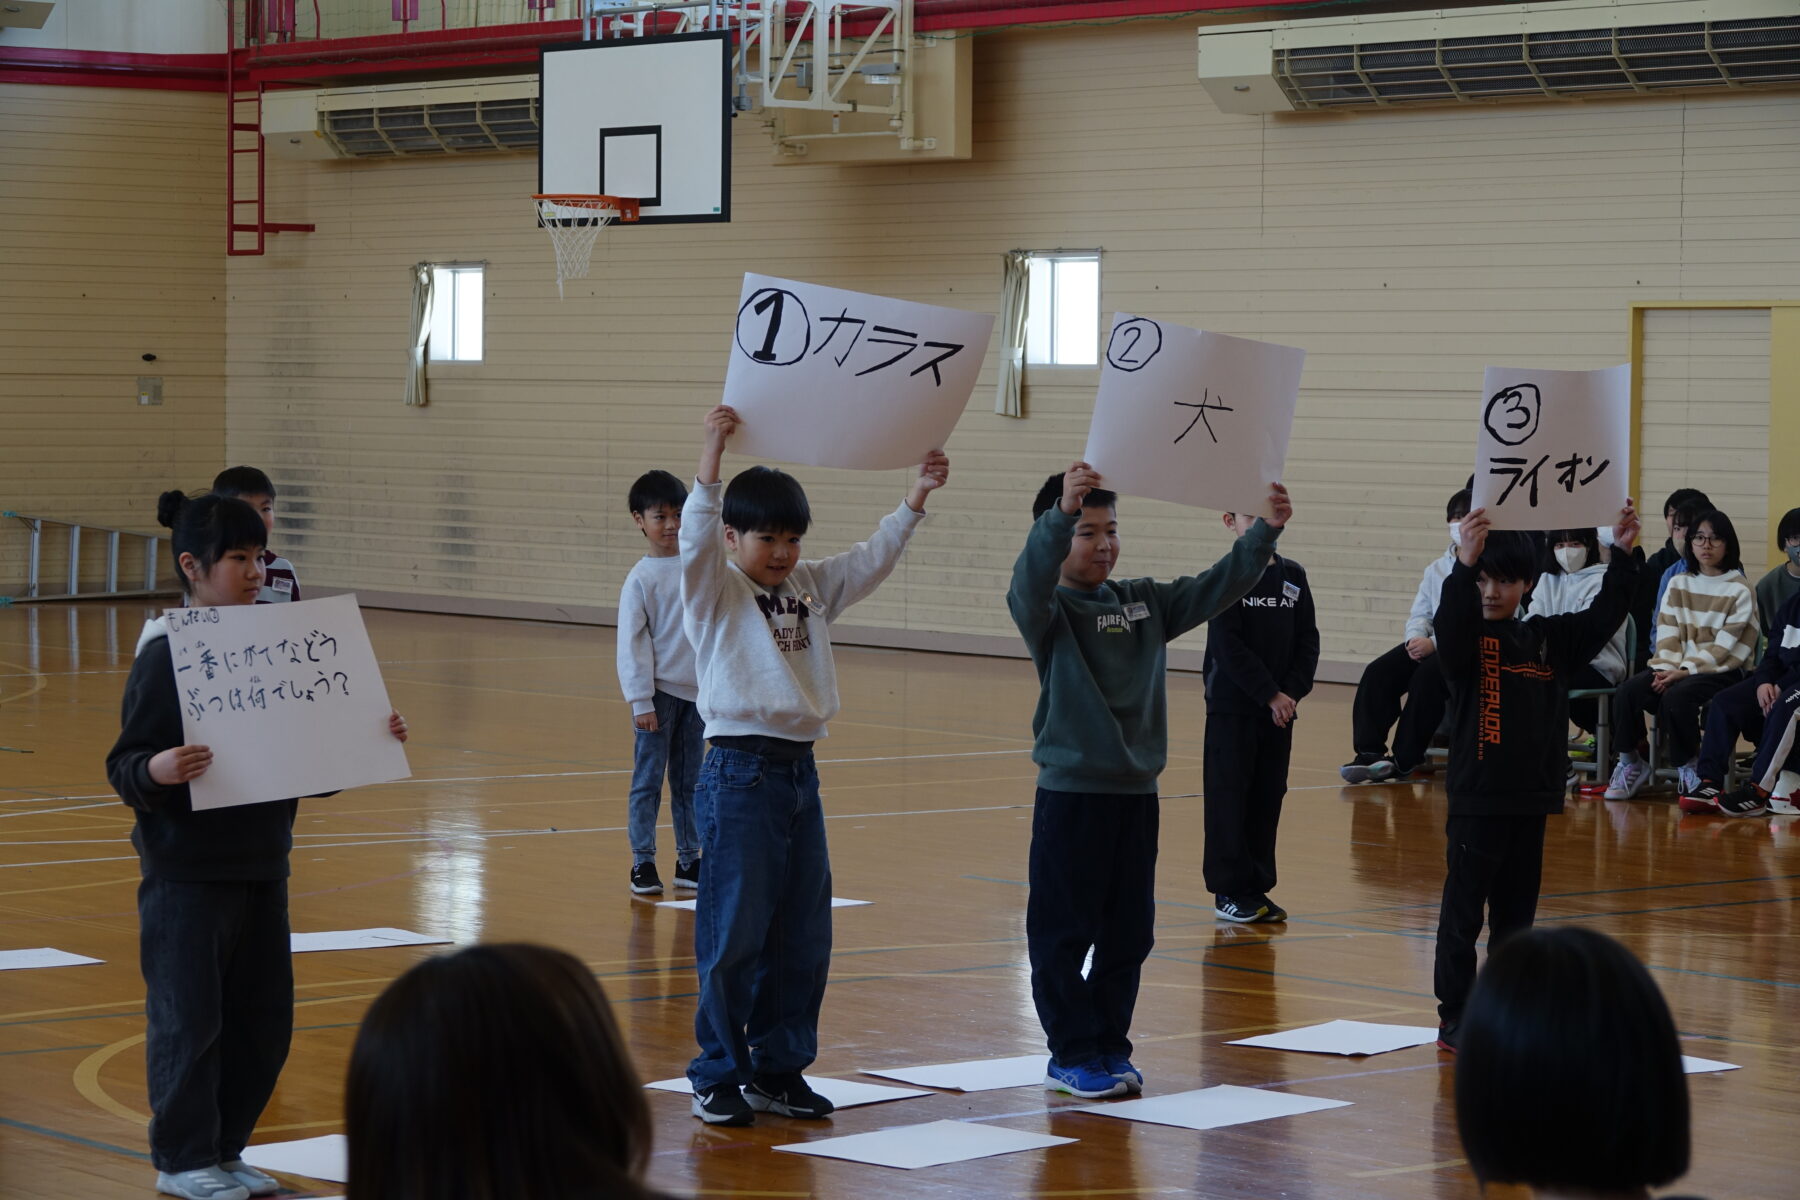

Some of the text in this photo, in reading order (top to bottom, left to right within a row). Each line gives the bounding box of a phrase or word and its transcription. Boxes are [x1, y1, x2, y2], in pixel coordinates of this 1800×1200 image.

[1173, 387, 1235, 444] 犬
[1489, 452, 1610, 508] ライオン
[1242, 596, 1278, 608] NIKE
[1483, 636, 1501, 744] ENDEAVOR
